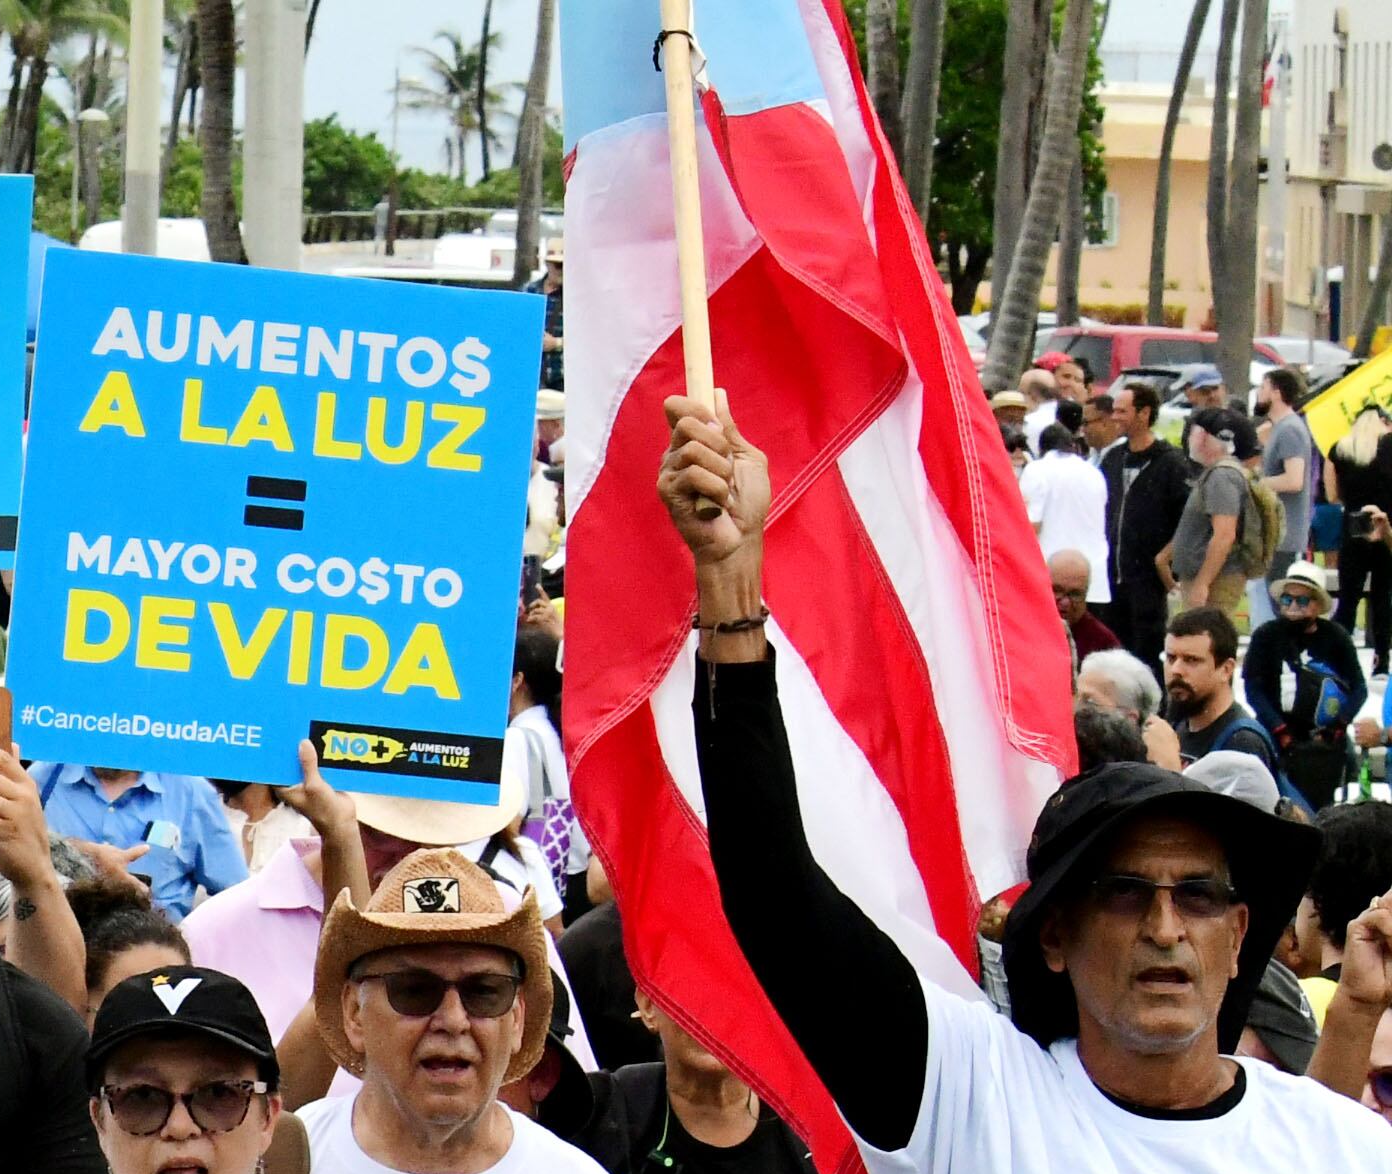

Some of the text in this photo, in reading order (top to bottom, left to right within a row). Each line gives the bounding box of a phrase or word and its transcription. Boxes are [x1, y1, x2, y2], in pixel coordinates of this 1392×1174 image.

[91, 307, 492, 398] AUMENTO$
[78, 371, 486, 472] A LA LUZ
[66, 532, 463, 609] MAYOR CO$TO
[63, 588, 461, 701] DE VIDA
[20, 704, 263, 749] #CancelaDeudaAEE
[408, 752, 469, 769] A LA LUZ
